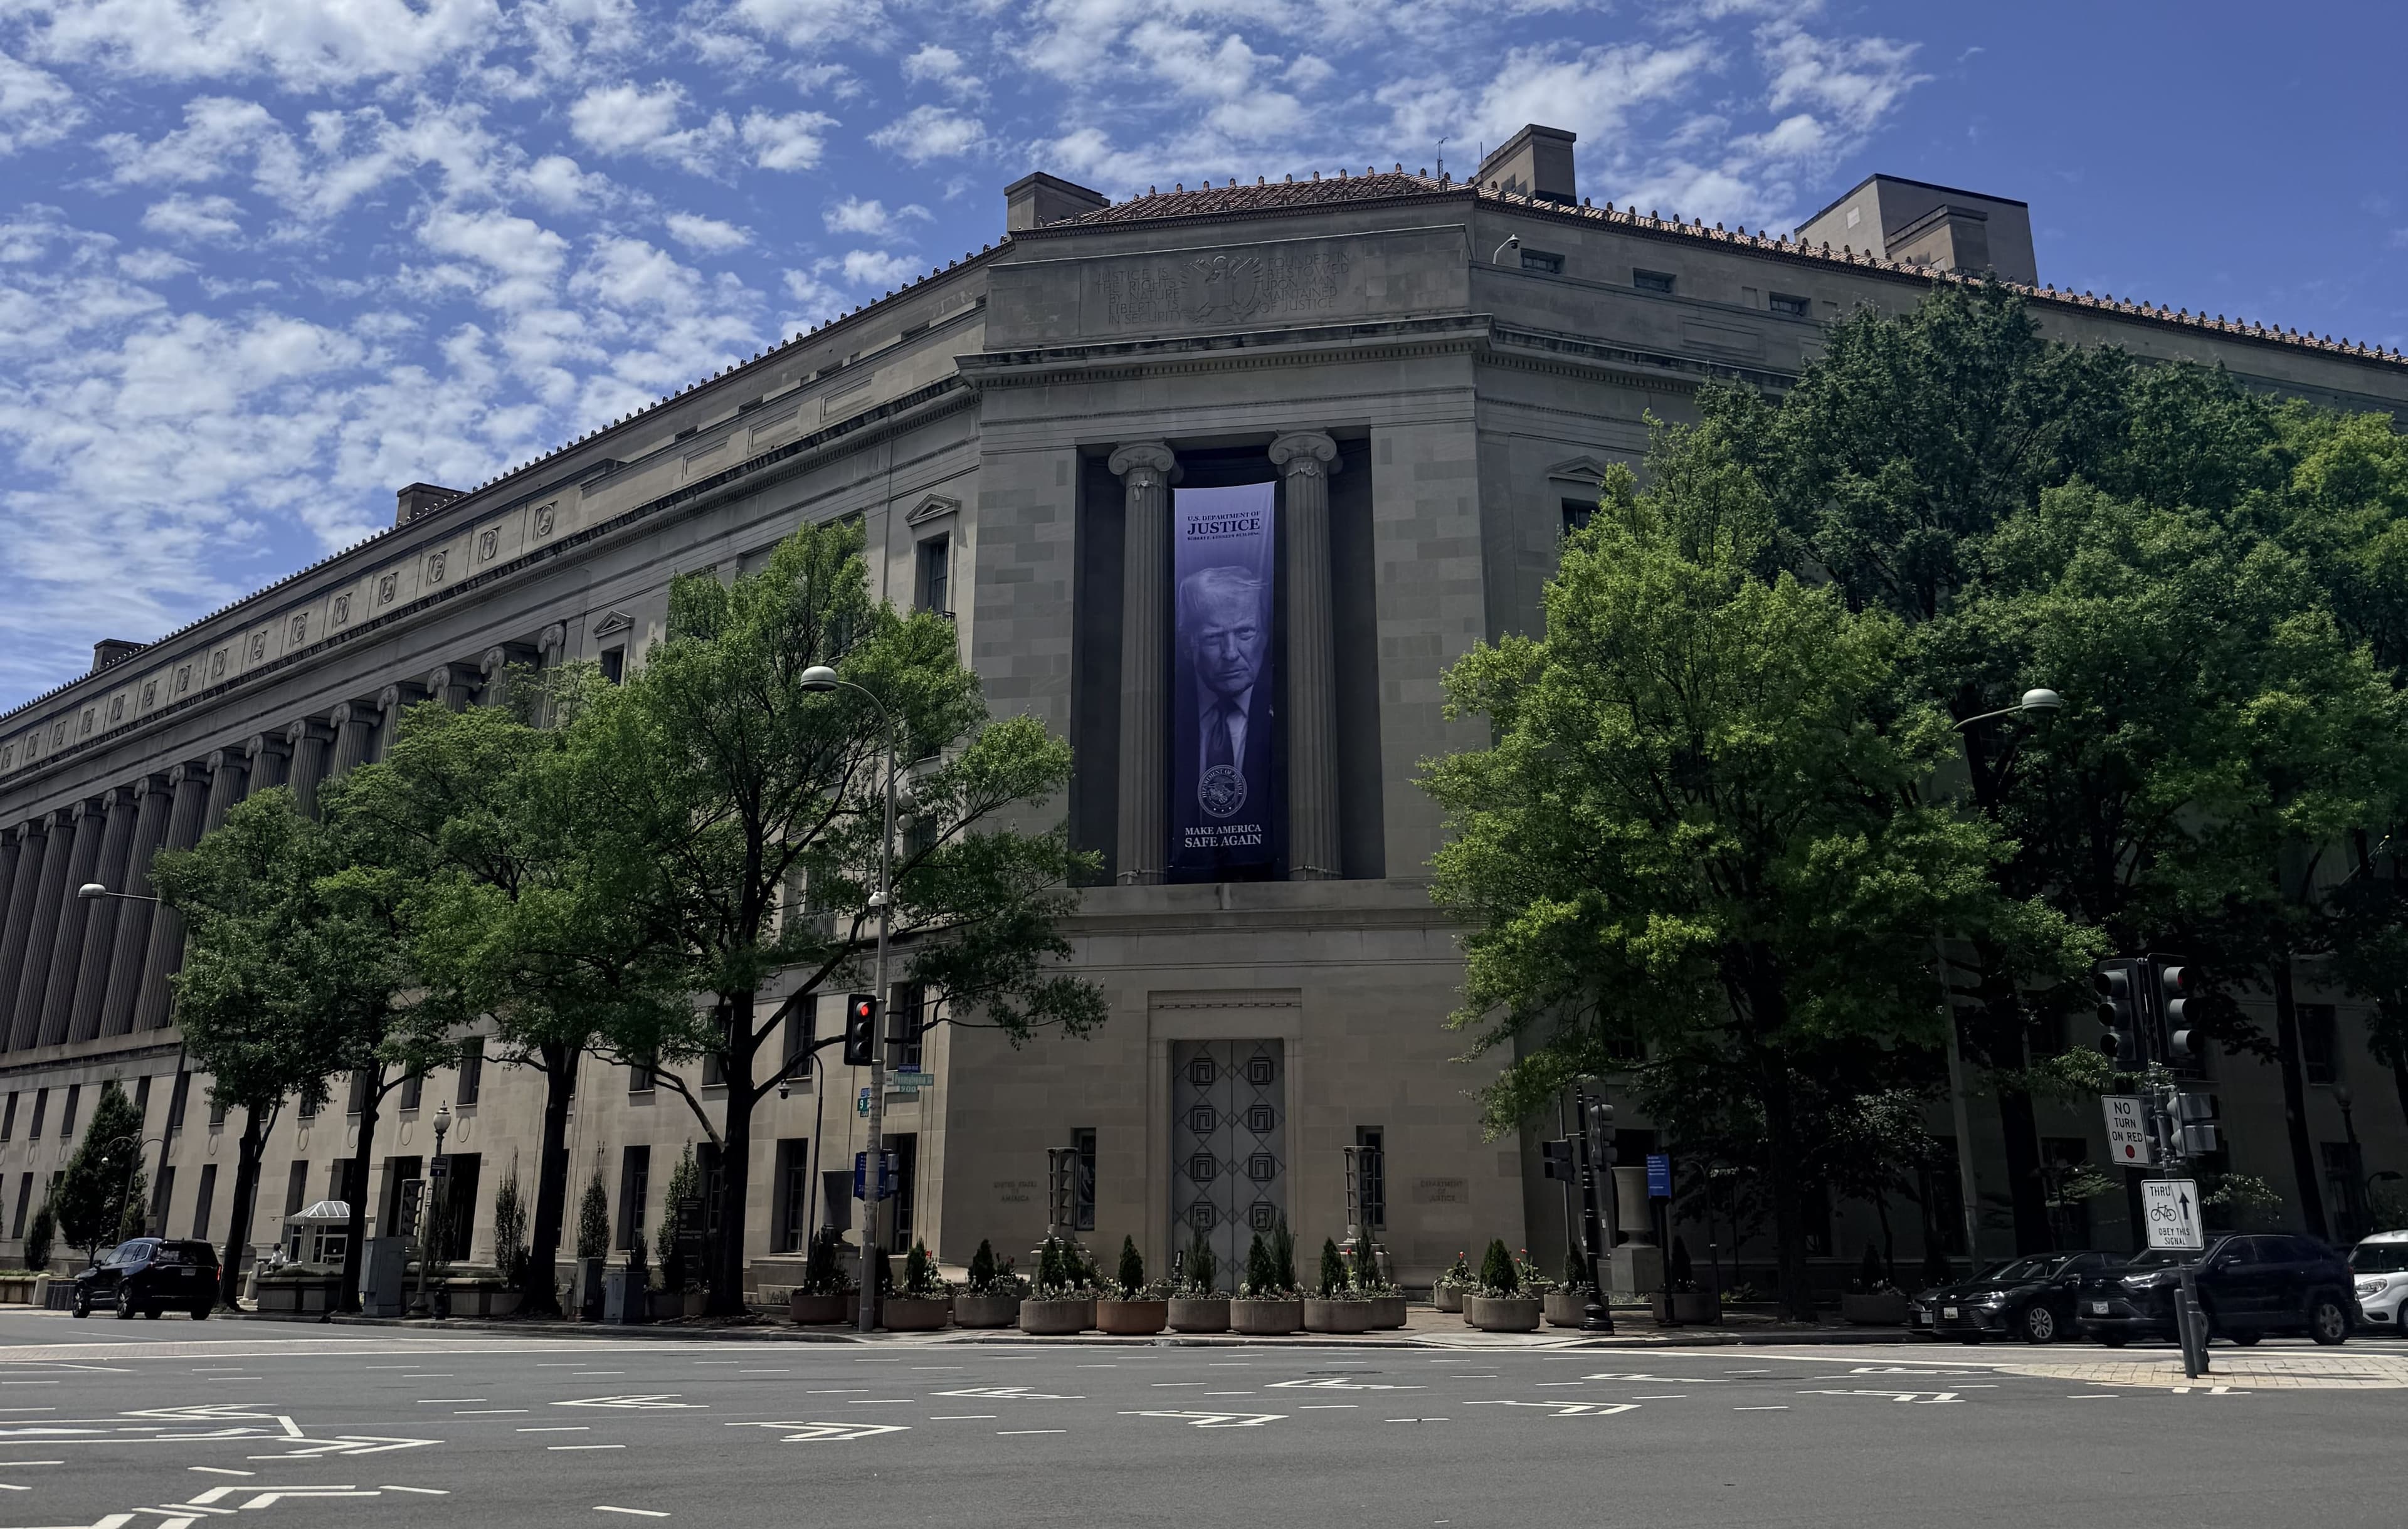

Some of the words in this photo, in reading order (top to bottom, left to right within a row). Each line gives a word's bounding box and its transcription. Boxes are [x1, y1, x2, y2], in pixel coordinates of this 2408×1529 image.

[1098, 269, 1149, 282] JUSTICE
[1158, 266, 1169, 278] IS
[1268, 253, 1329, 267] FOUNDED
[1337, 251, 1349, 263] IN
[1094, 281, 1119, 294] THE
[1129, 278, 1176, 292] RIGHTS
[1268, 263, 1349, 280] BESTOWED
[1109, 293, 1122, 303] BY
[1130, 288, 1179, 302] NATURE
[1261, 279, 1297, 291] UPON
[1306, 275, 1336, 286] MAN
[1109, 301, 1159, 314] LIBERTY
[1168, 300, 1179, 311] IS
[1263, 286, 1337, 301] MAINTAINED
[1109, 315, 1119, 325] IN
[1260, 302, 1277, 313] OF
[1283, 297, 1335, 312] JUSTICE
[1202, 512, 1250, 521] DEPARTMENT
[1187, 518, 1260, 535] JUSTICE
[1185, 827, 1214, 836] MAKE
[1216, 824, 1262, 834] AMERICA
[1185, 836, 1218, 848] SAFE
[1221, 834, 1262, 847] AGAIN
[2114, 1101, 2131, 1115] NO
[2114, 1118, 2136, 1128] TURN
[2112, 1131, 2123, 1142] ON
[2126, 1132, 2143, 1142] RED
[2149, 1185, 2171, 1197] THRU
[2158, 1227, 2174, 1236] OBEY
[2175, 1227, 2190, 1236] THIS
[2164, 1237, 2186, 1245] SIGNAL
